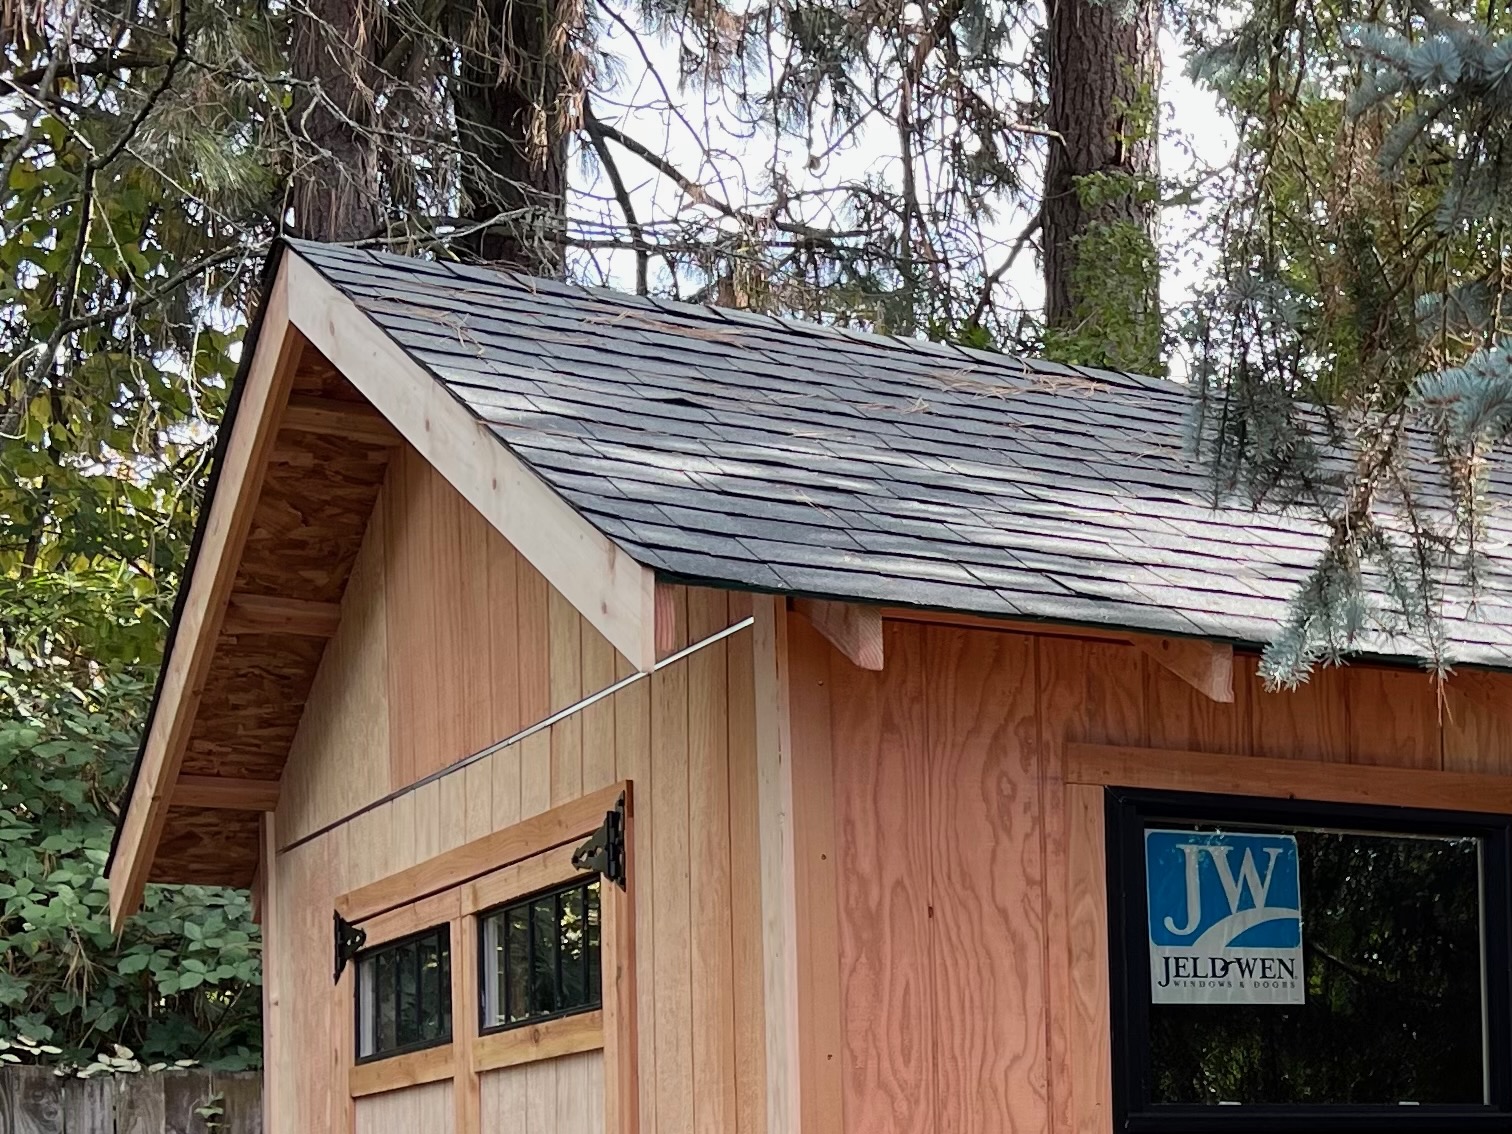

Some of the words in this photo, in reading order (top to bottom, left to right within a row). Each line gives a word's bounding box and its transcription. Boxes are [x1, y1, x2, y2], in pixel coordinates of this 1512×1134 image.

[1163, 844, 1284, 936] JW
[1157, 956, 1296, 988] JELD-WEN
[1173, 980, 1233, 989] WINDOWS
